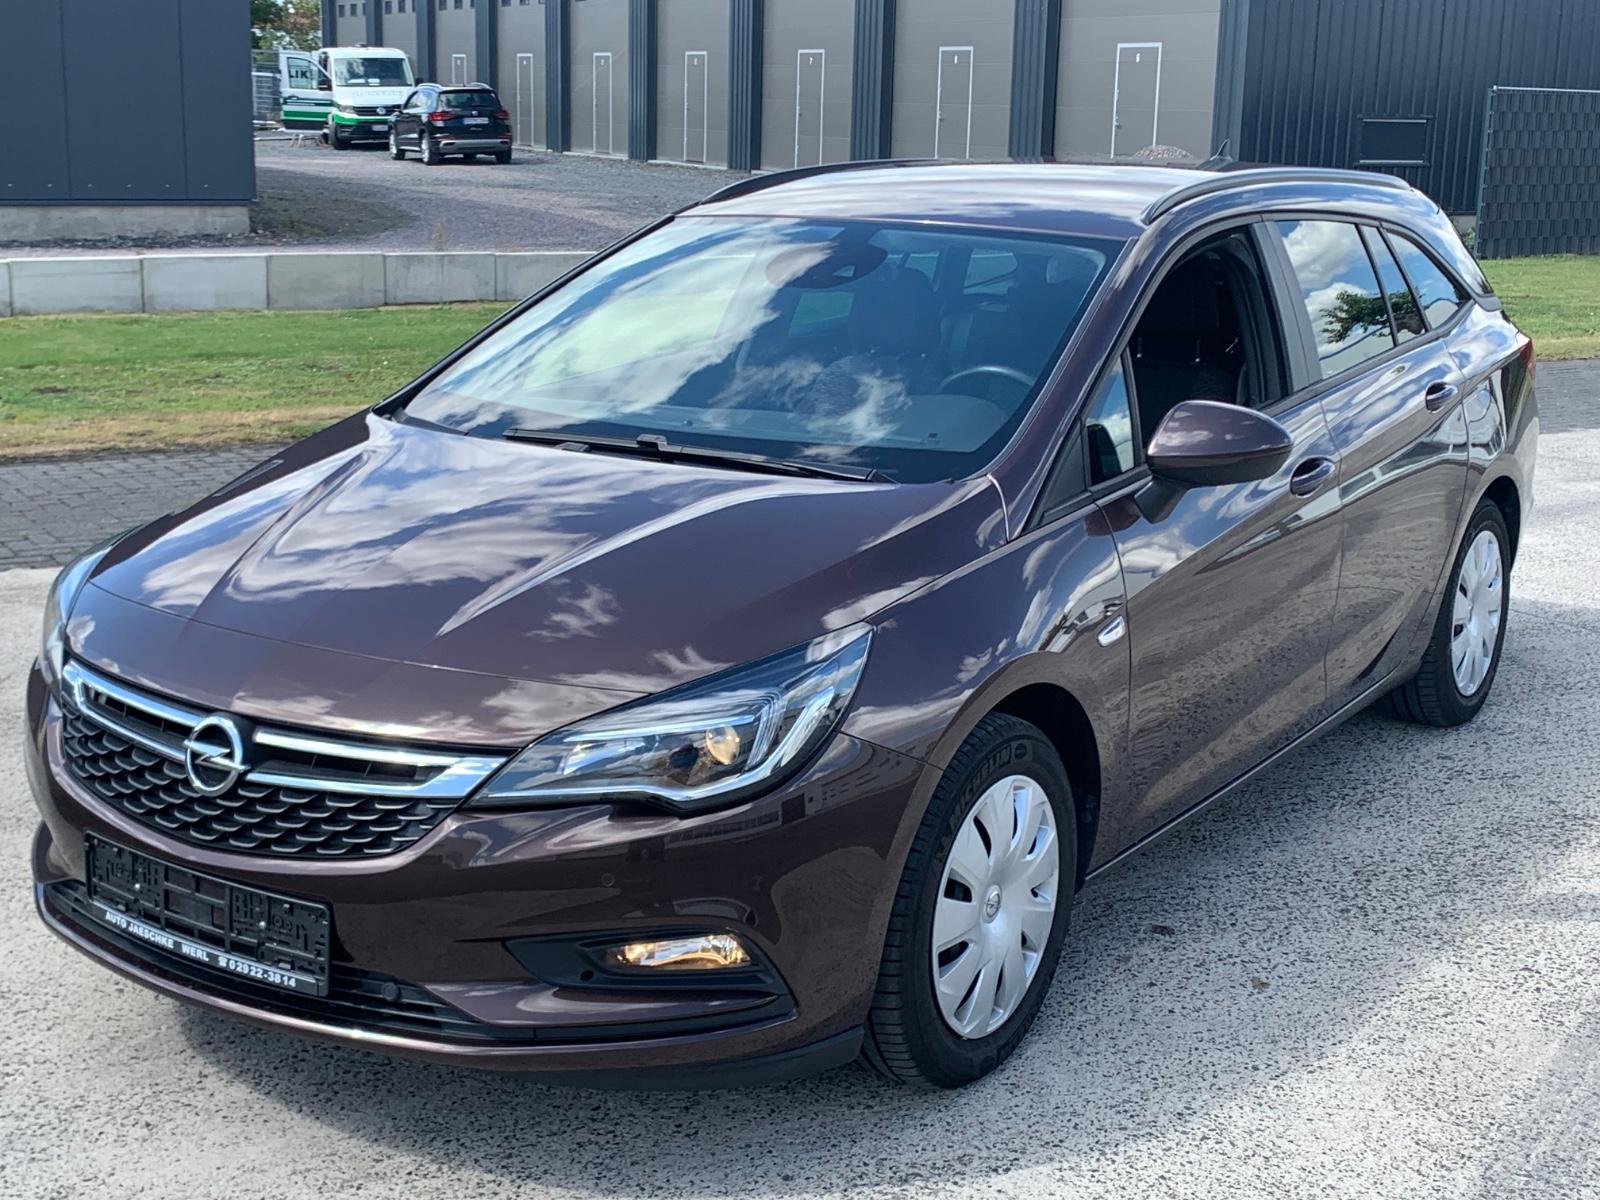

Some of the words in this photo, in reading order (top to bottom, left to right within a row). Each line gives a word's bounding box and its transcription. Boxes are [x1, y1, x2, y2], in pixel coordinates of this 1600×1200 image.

[105, 910, 127, 929] AUTO
[128, 921, 175, 949] JAESCHKE
[181, 943, 210, 962] WERL
[229, 960, 297, 988] 02922-3814
